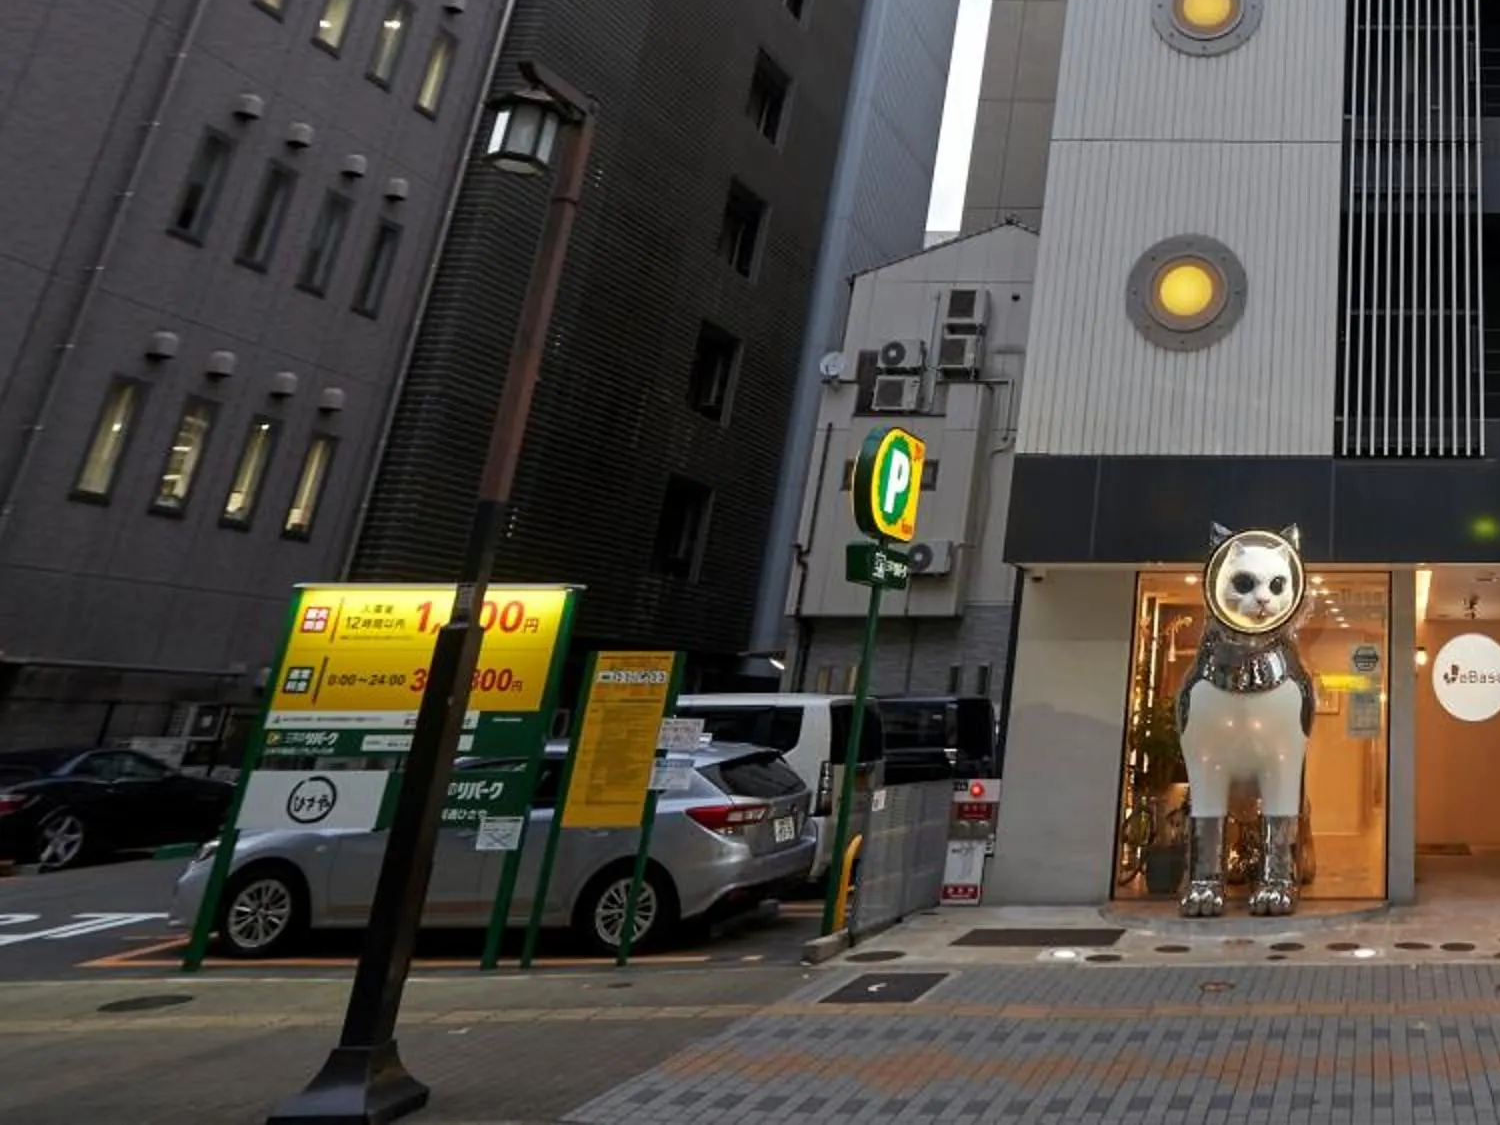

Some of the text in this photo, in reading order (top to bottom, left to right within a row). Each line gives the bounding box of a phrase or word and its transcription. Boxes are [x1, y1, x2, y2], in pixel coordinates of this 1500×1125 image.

[883, 449, 910, 514] P
[346, 616, 406, 630] 12時間以内
[416, 600, 540, 635] 1,00円
[447, 780, 505, 800] のリパーク
